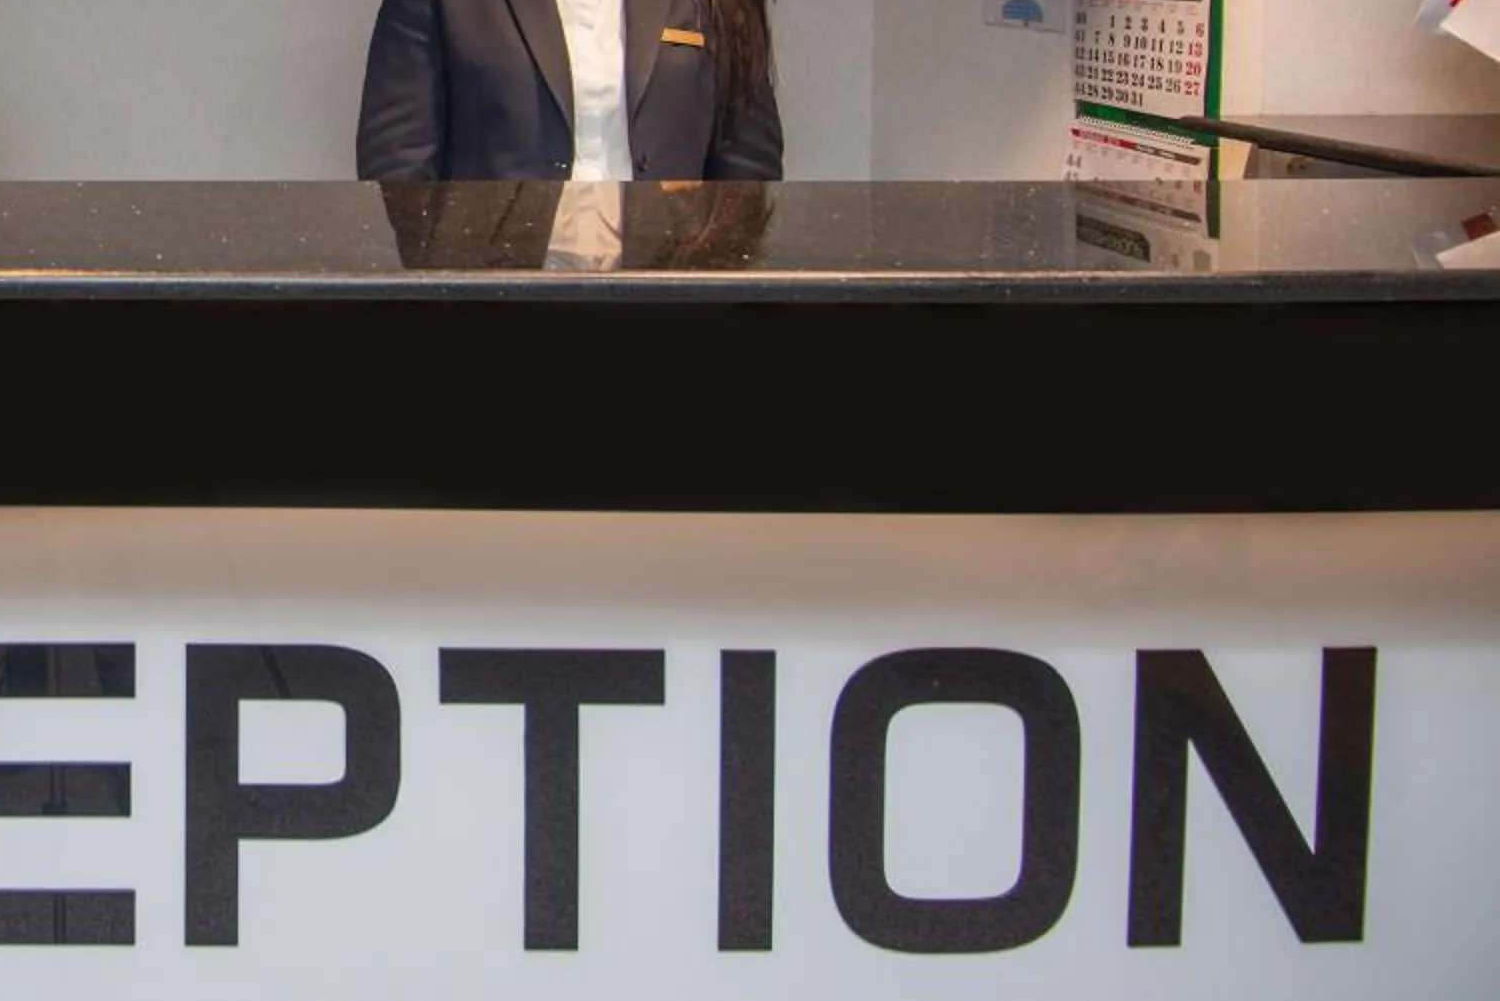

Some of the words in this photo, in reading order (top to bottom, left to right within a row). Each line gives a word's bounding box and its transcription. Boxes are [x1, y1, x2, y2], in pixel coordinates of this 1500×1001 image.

[1110, 14, 1115, 29] 1
[1124, 15, 1132, 30] 2
[1141, 17, 1149, 32] 3
[1158, 18, 1165, 34] 4
[1195, 22, 1205, 38] 6
[1107, 32, 1115, 48] 8
[1123, 34, 1131, 48] 9
[1134, 35, 1148, 50] 10
[1151, 38, 1163, 53] 11
[1169, 40, 1183, 55] 12
[1188, 42, 1203, 57] 13
[1088, 47, 1099, 63] 14
[1102, 49, 1114, 64] 15
[1118, 52, 1130, 66] 16
[1133, 54, 1146, 68] 17
[1150, 57, 1164, 71] 18
[1168, 59, 1183, 74] 19
[1185, 61, 1202, 77] 20
[1116, 70, 1129, 85] 23
[1131, 72, 1145, 87] 24
[1148, 75, 1163, 90] 25
[1165, 78, 1181, 94] 26
[1184, 80, 1200, 96] 27
[1131, 90, 1143, 107] 31
